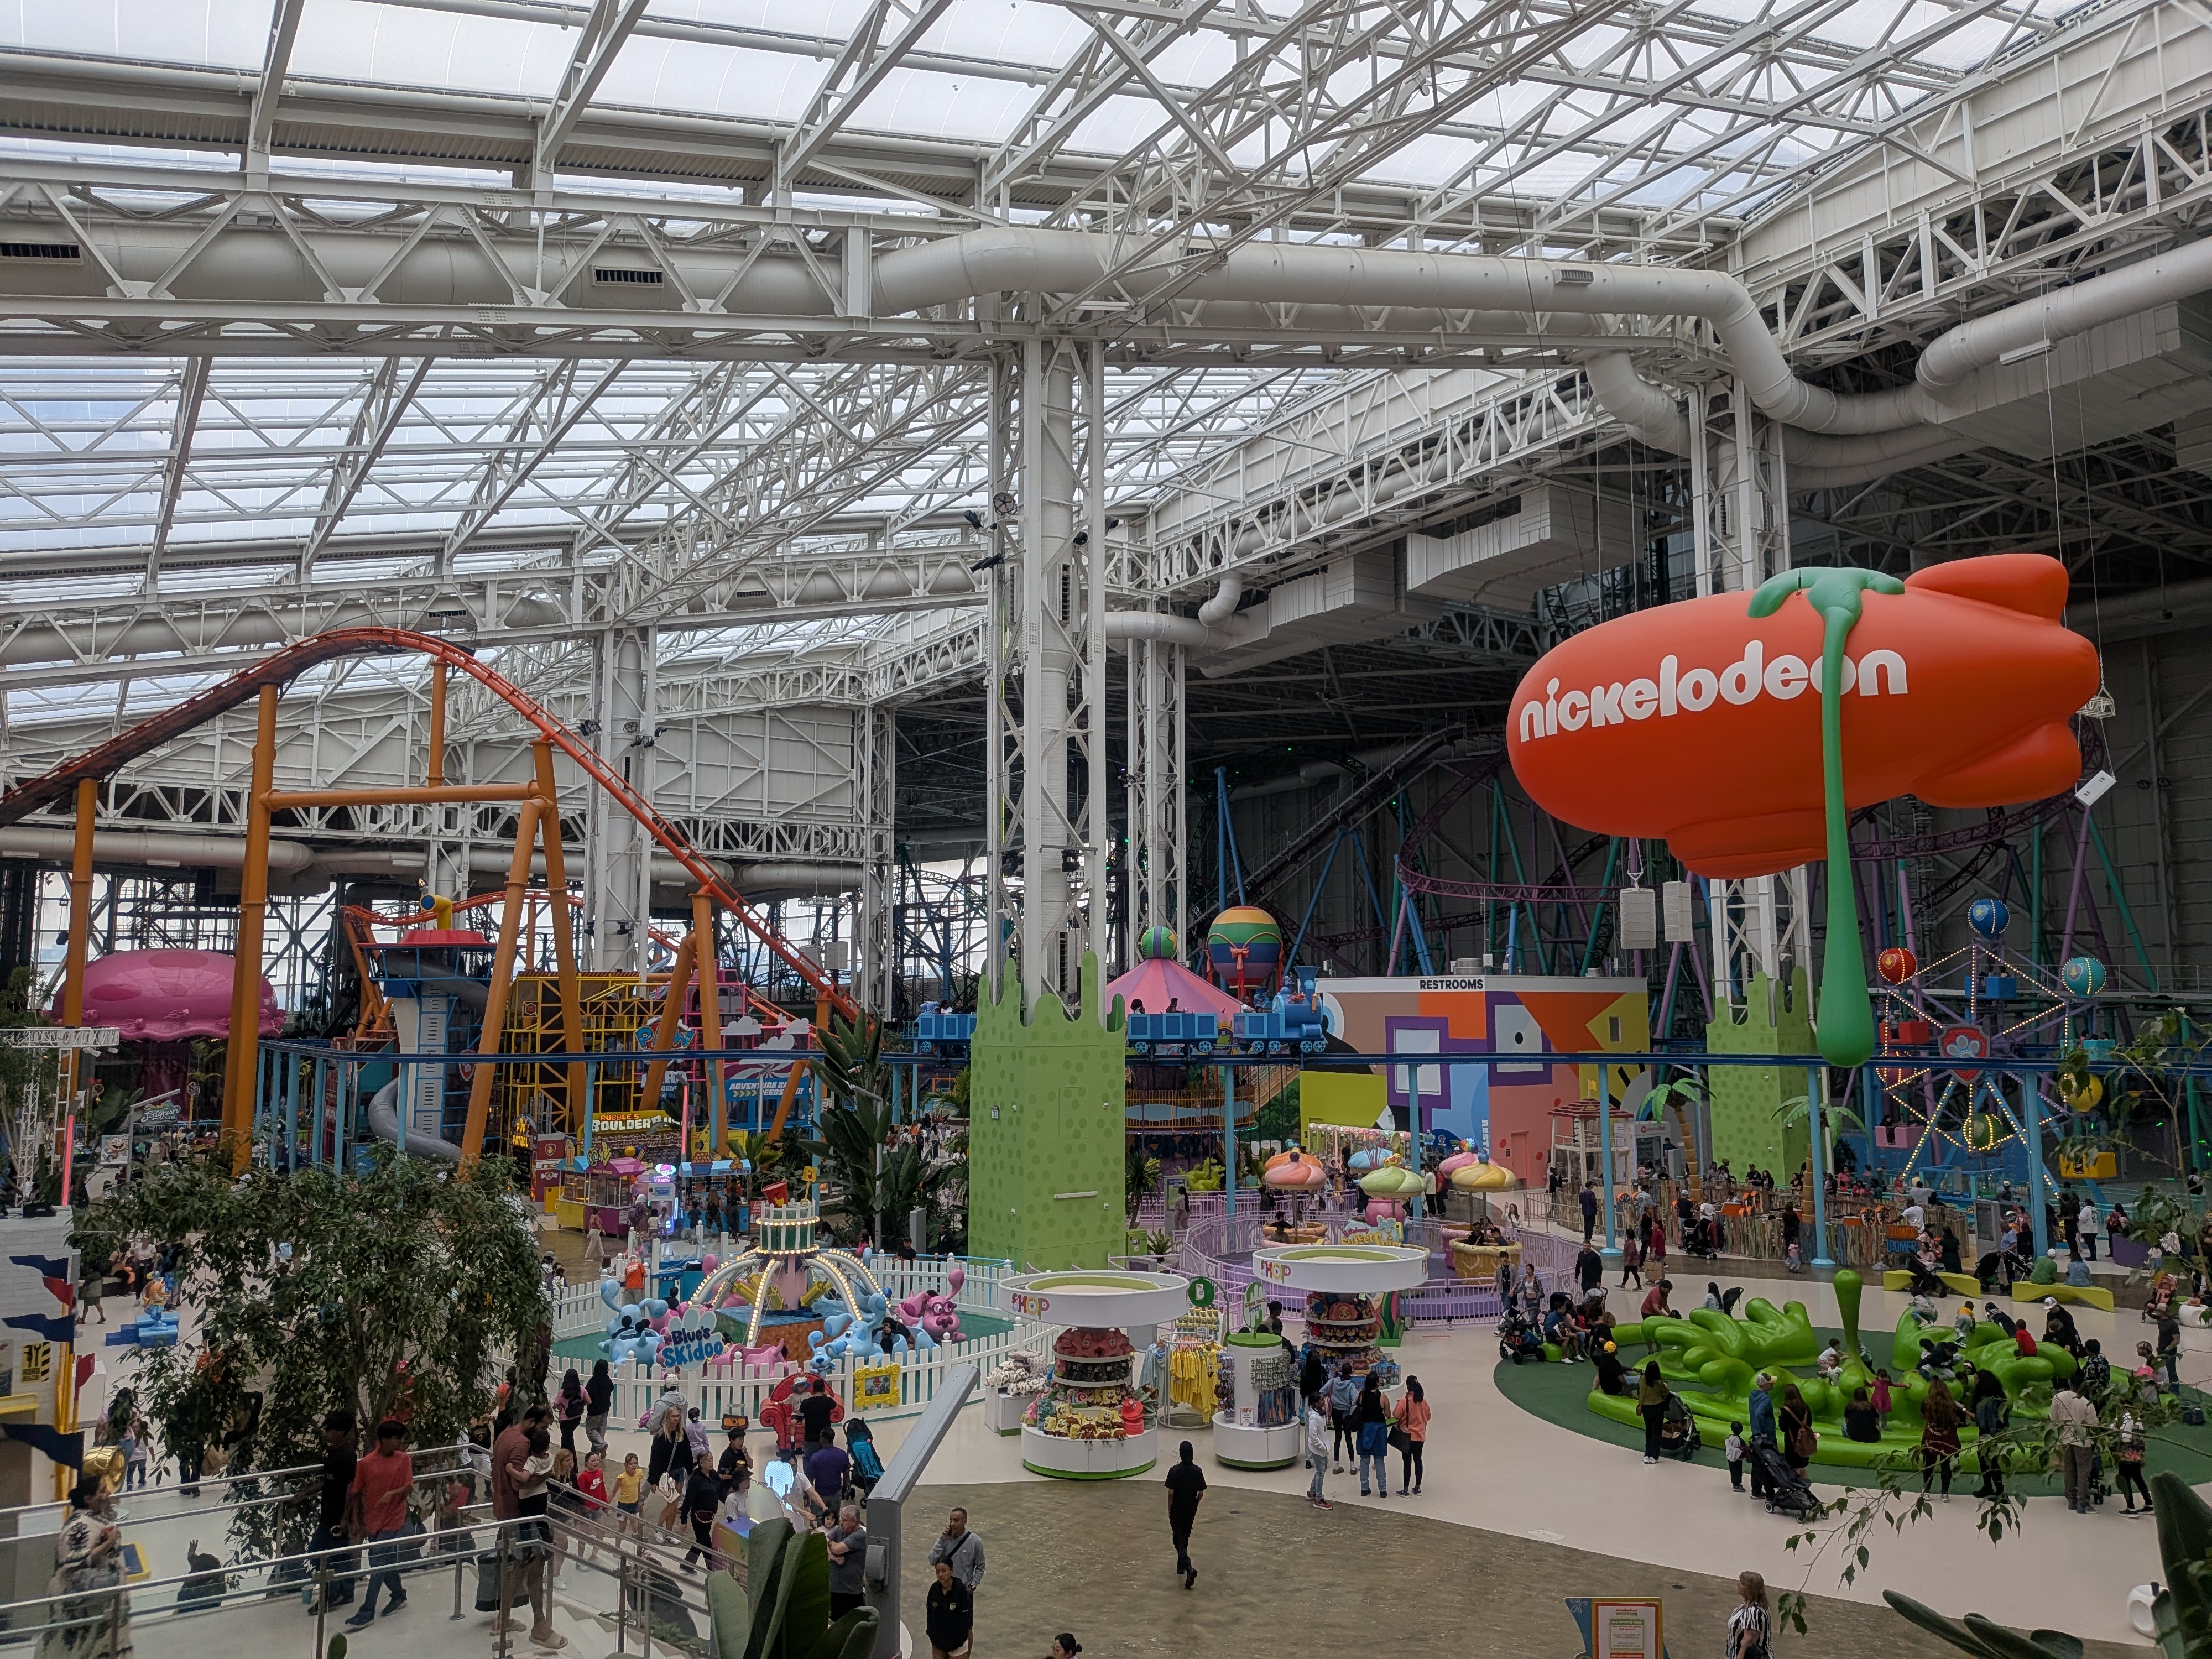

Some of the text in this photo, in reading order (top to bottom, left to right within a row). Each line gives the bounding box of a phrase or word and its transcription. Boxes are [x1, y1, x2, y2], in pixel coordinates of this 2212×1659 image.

[1520, 639, 1908, 743] nickelodeon
[1420, 979, 1484, 990] RESTROOMS
[635, 1027, 695, 1050] PW
[513, 1134, 528, 1148] PATROL
[1890, 1226, 1914, 1237] ZUMA'S
[1885, 1239, 1919, 1253] ZOOMER
[1260, 1260, 1292, 1285] SHOP
[1011, 1293, 1050, 1321] SHOP
[671, 1326, 711, 1345] Blue's
